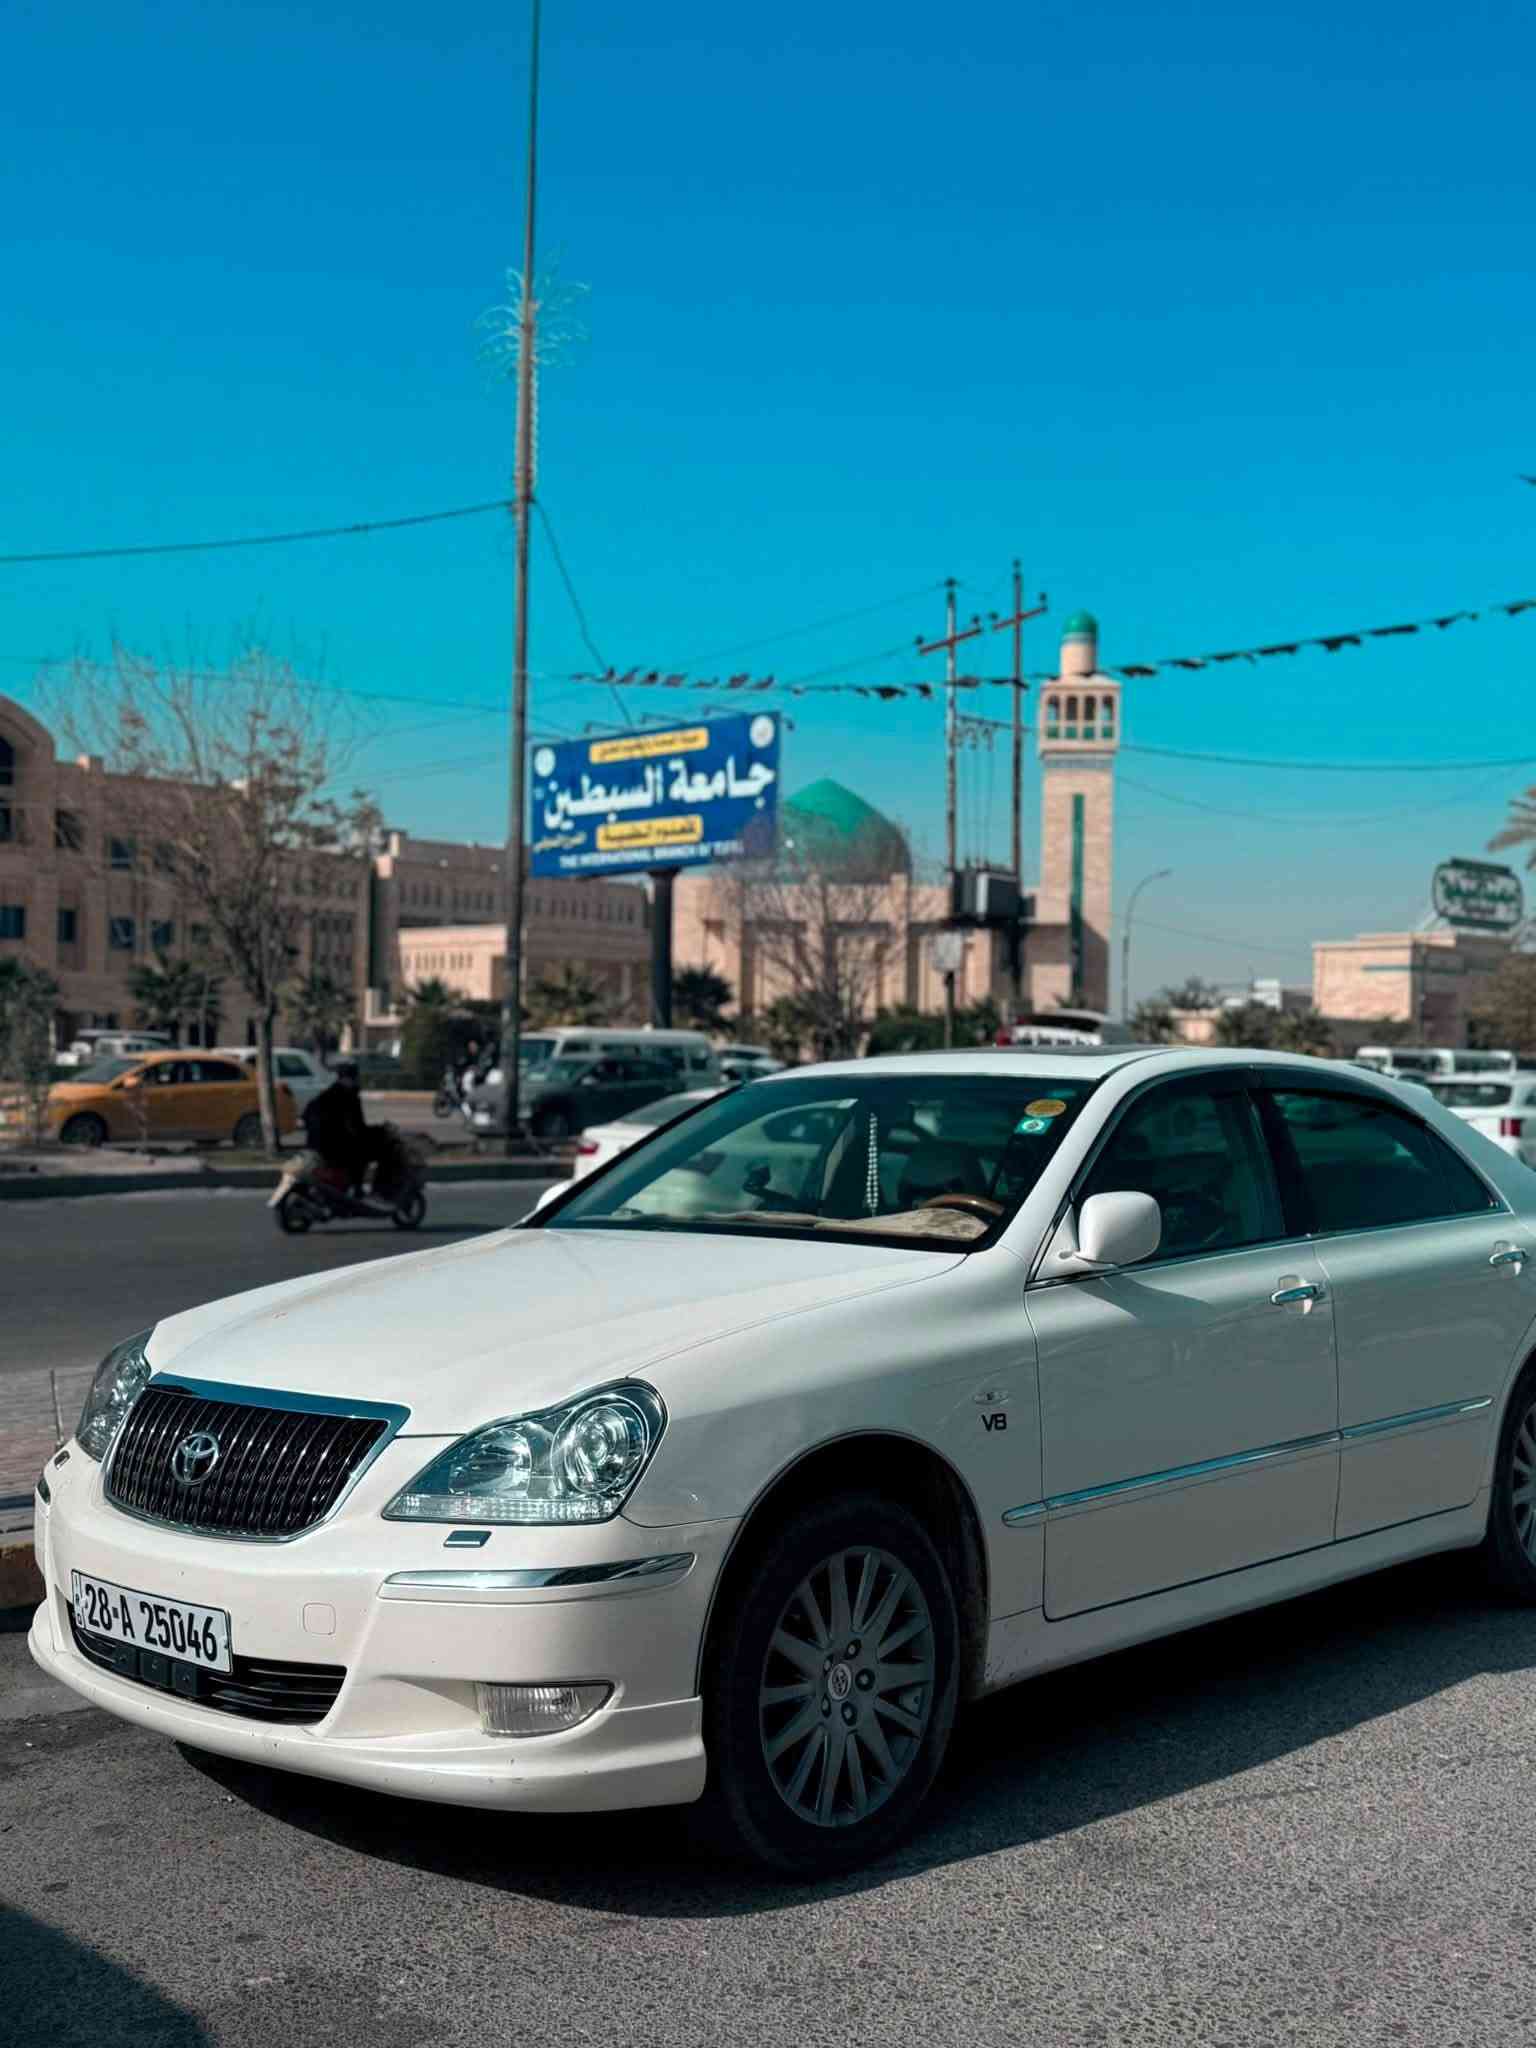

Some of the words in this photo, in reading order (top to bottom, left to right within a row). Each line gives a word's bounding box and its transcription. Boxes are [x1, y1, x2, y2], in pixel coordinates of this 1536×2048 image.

[544, 763, 664, 830] السبطين
[667, 755, 775, 809] جامعة
[981, 1413, 1007, 1432] V8
[85, 1583, 135, 1639] 28-A
[140, 1601, 217, 1662] 25046
